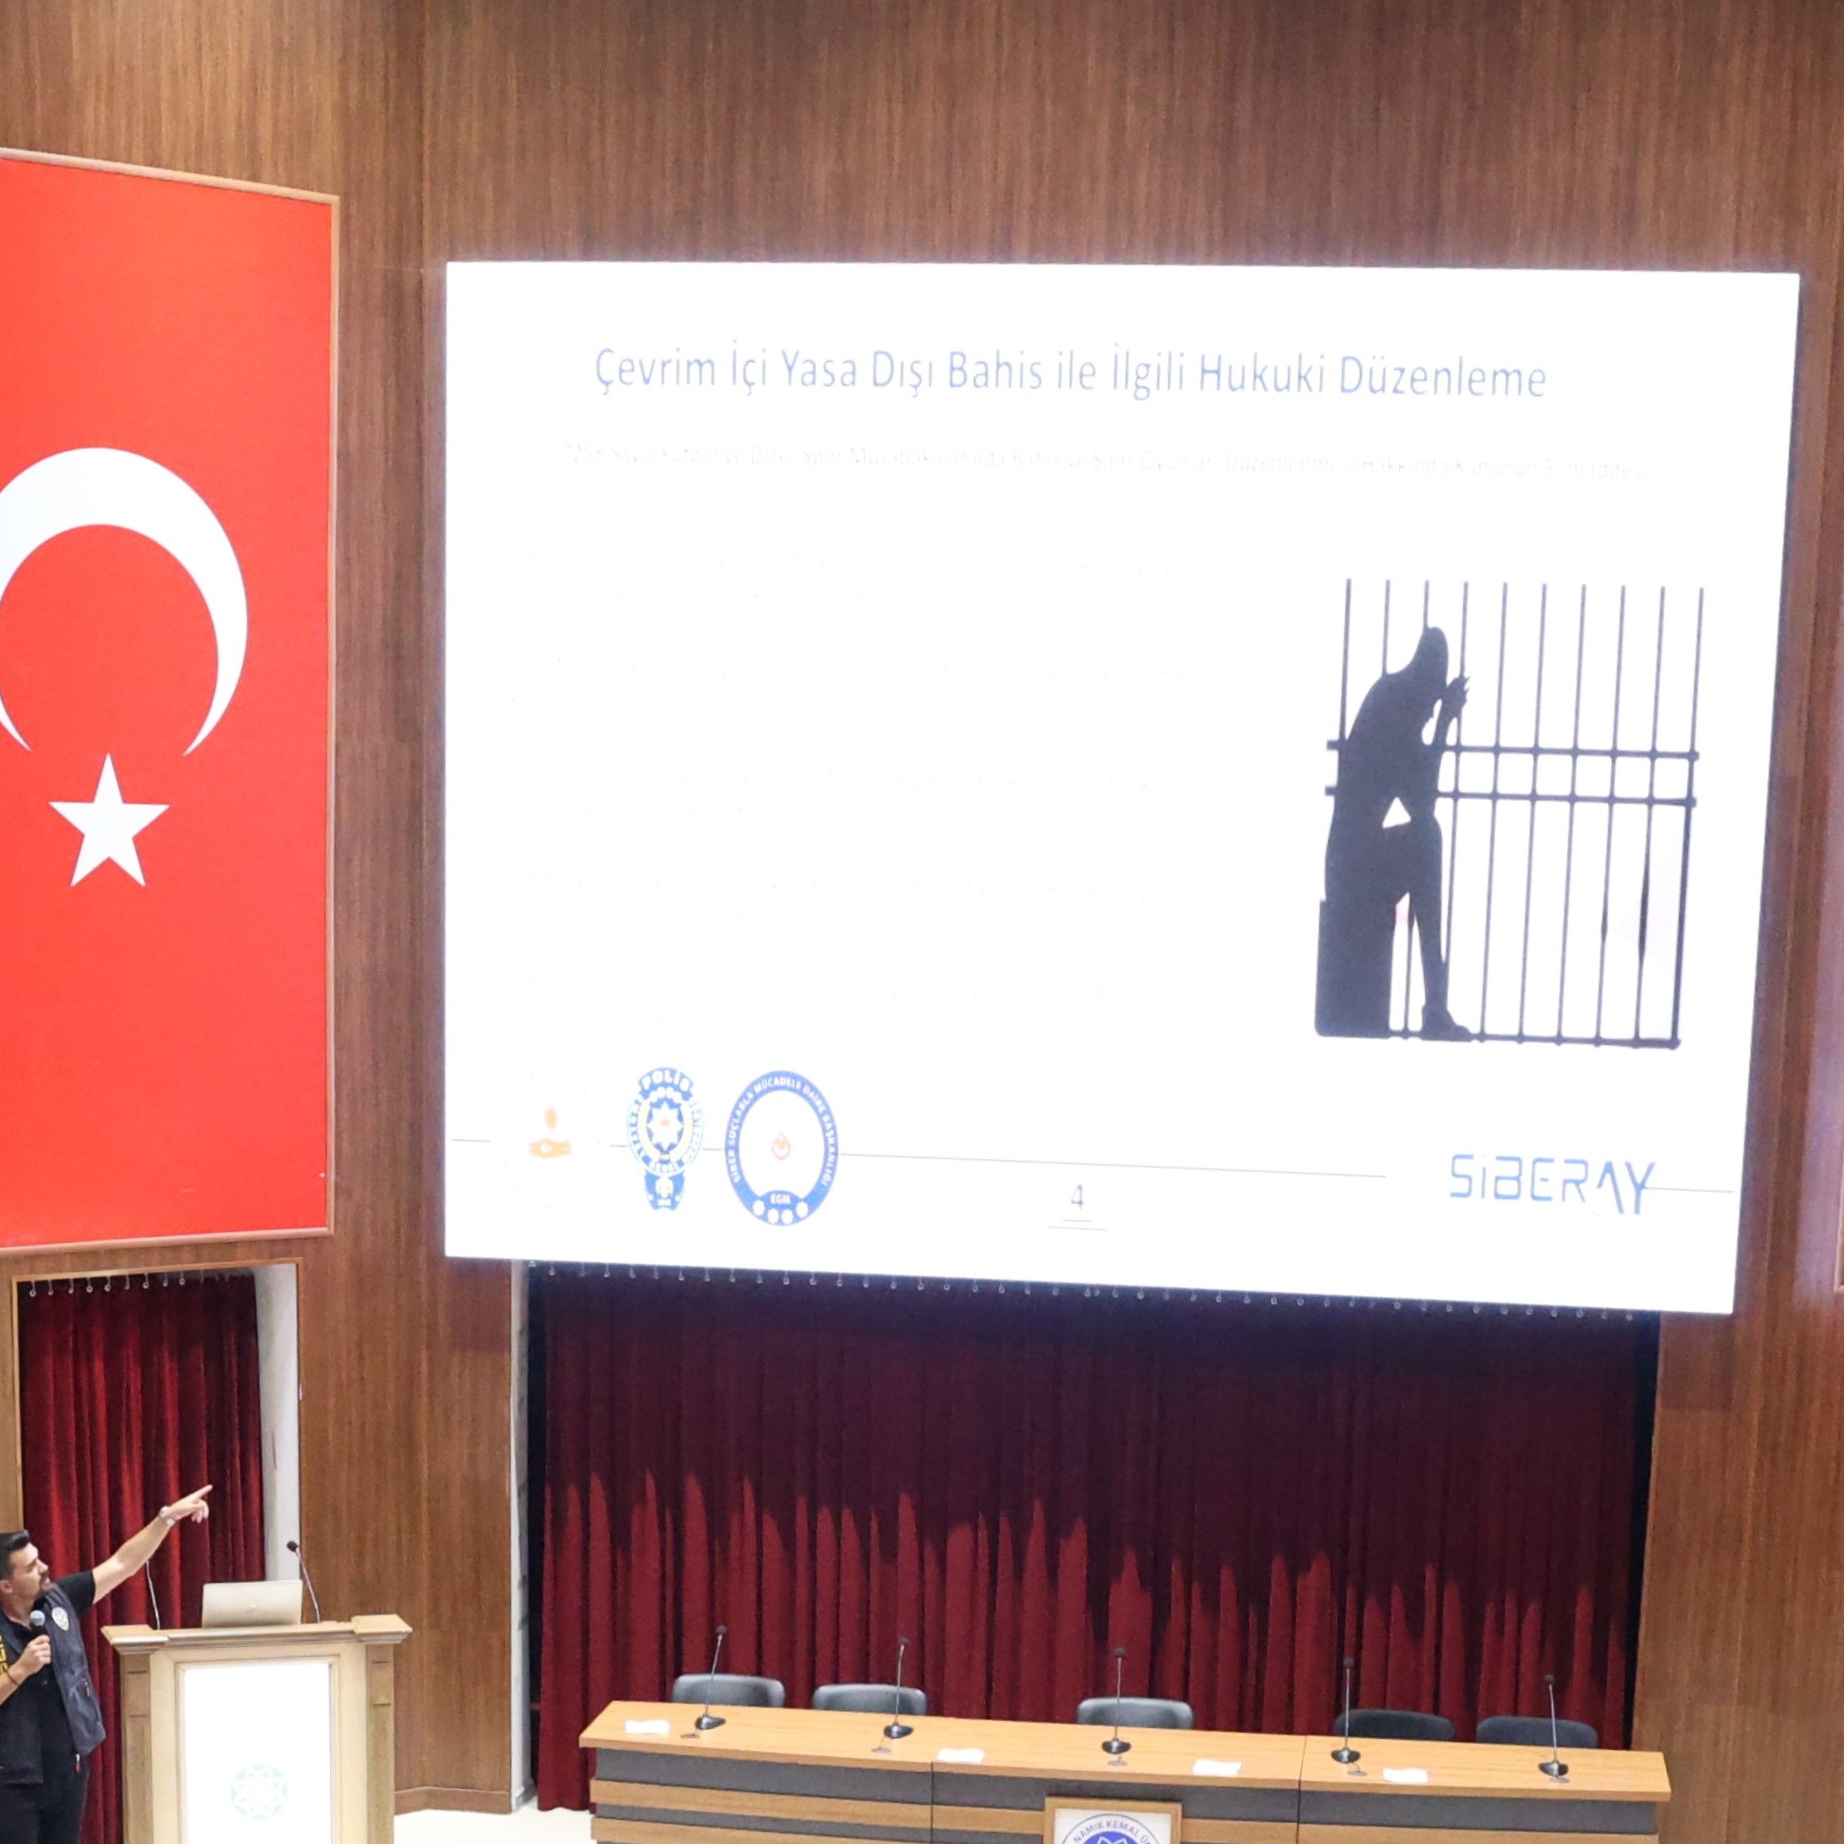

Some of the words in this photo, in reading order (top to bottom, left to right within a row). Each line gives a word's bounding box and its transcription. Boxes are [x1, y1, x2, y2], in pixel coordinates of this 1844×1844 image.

[595, 349, 715, 395] Çevrim
[782, 351, 857, 388] Yasa
[872, 350, 933, 398] Dışı
[948, 351, 1043, 390] Bahis
[1058, 352, 1096, 390] ile
[1111, 341, 1184, 402] İlgili
[1200, 354, 1324, 392] Hukuki
[1340, 356, 1547, 398] Düzenleme
[1071, 1184, 1084, 1210] 4
